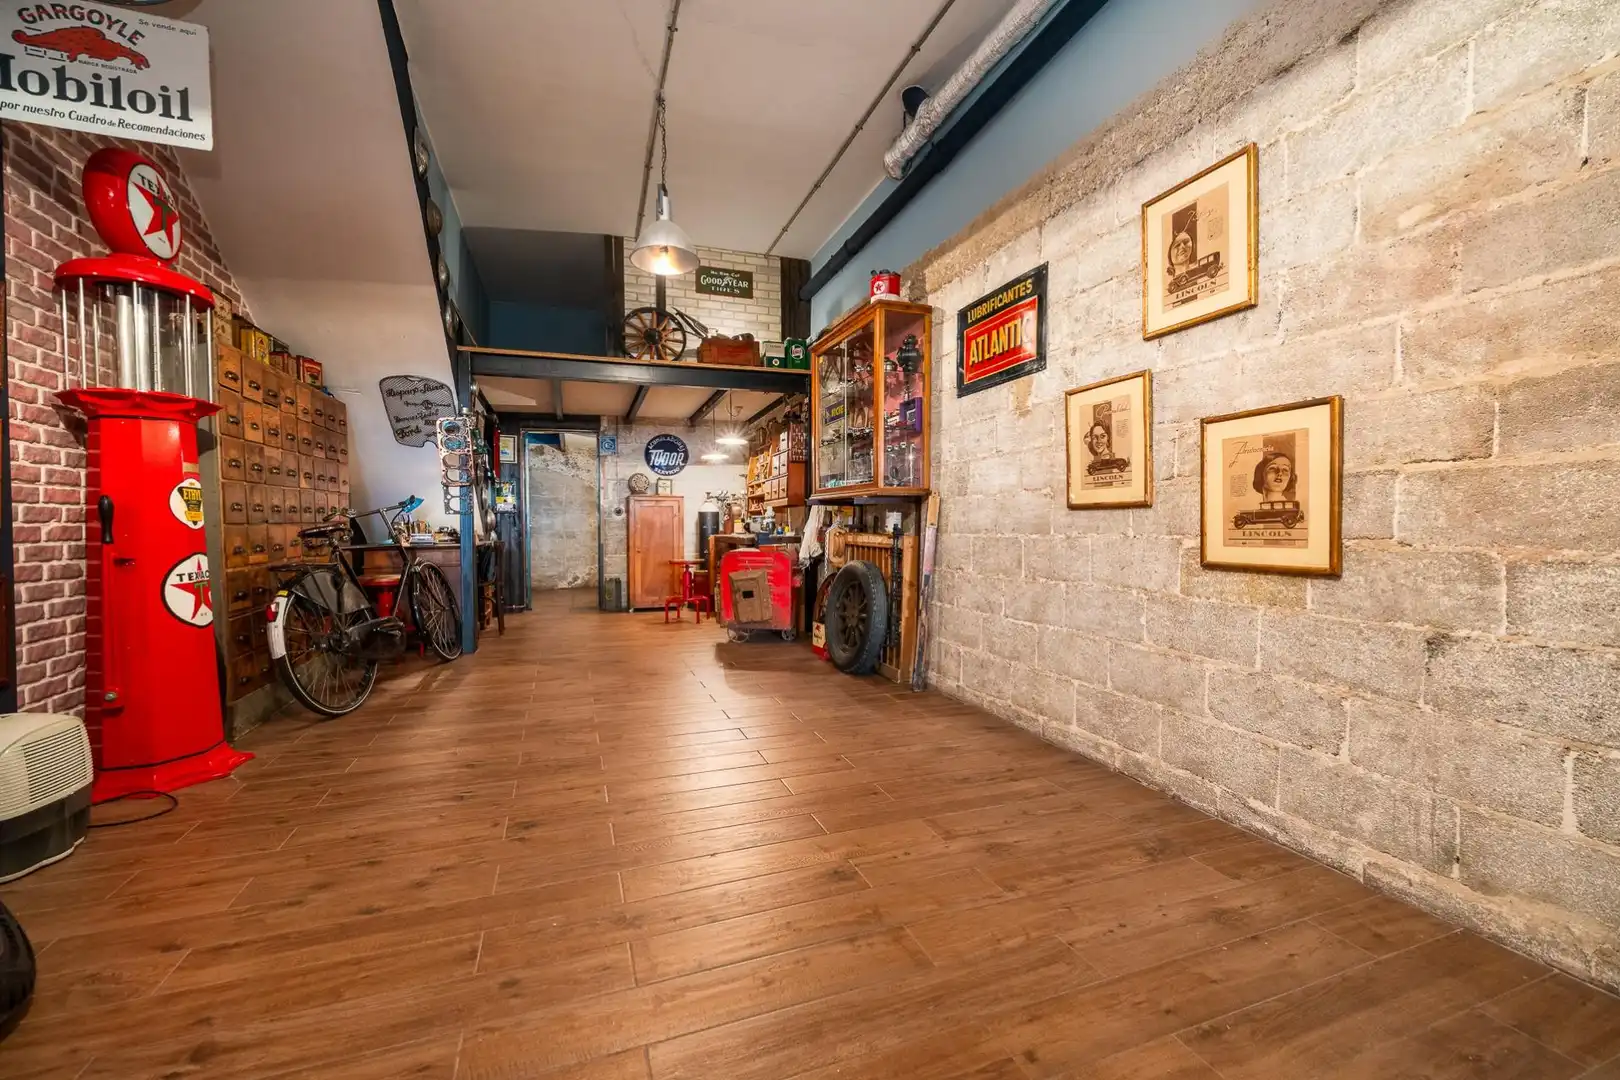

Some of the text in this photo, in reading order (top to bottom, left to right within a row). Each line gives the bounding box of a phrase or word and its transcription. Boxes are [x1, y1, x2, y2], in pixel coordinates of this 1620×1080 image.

[17, 3, 146, 46] GARGOYLE
[22, 104, 65, 119] nuestro
[68, 110, 107, 126] Cuadro
[107, 119, 117, 127] de
[117, 118, 206, 141] Recomendaciones
[700, 274, 749, 288] GOODYEAR
[1175, 280, 1217, 299] LINCOLN
[967, 279, 1033, 323] LUBRIFICANTES
[649, 449, 685, 466] TUDOR
[1092, 474, 1124, 482] LINCOLN
